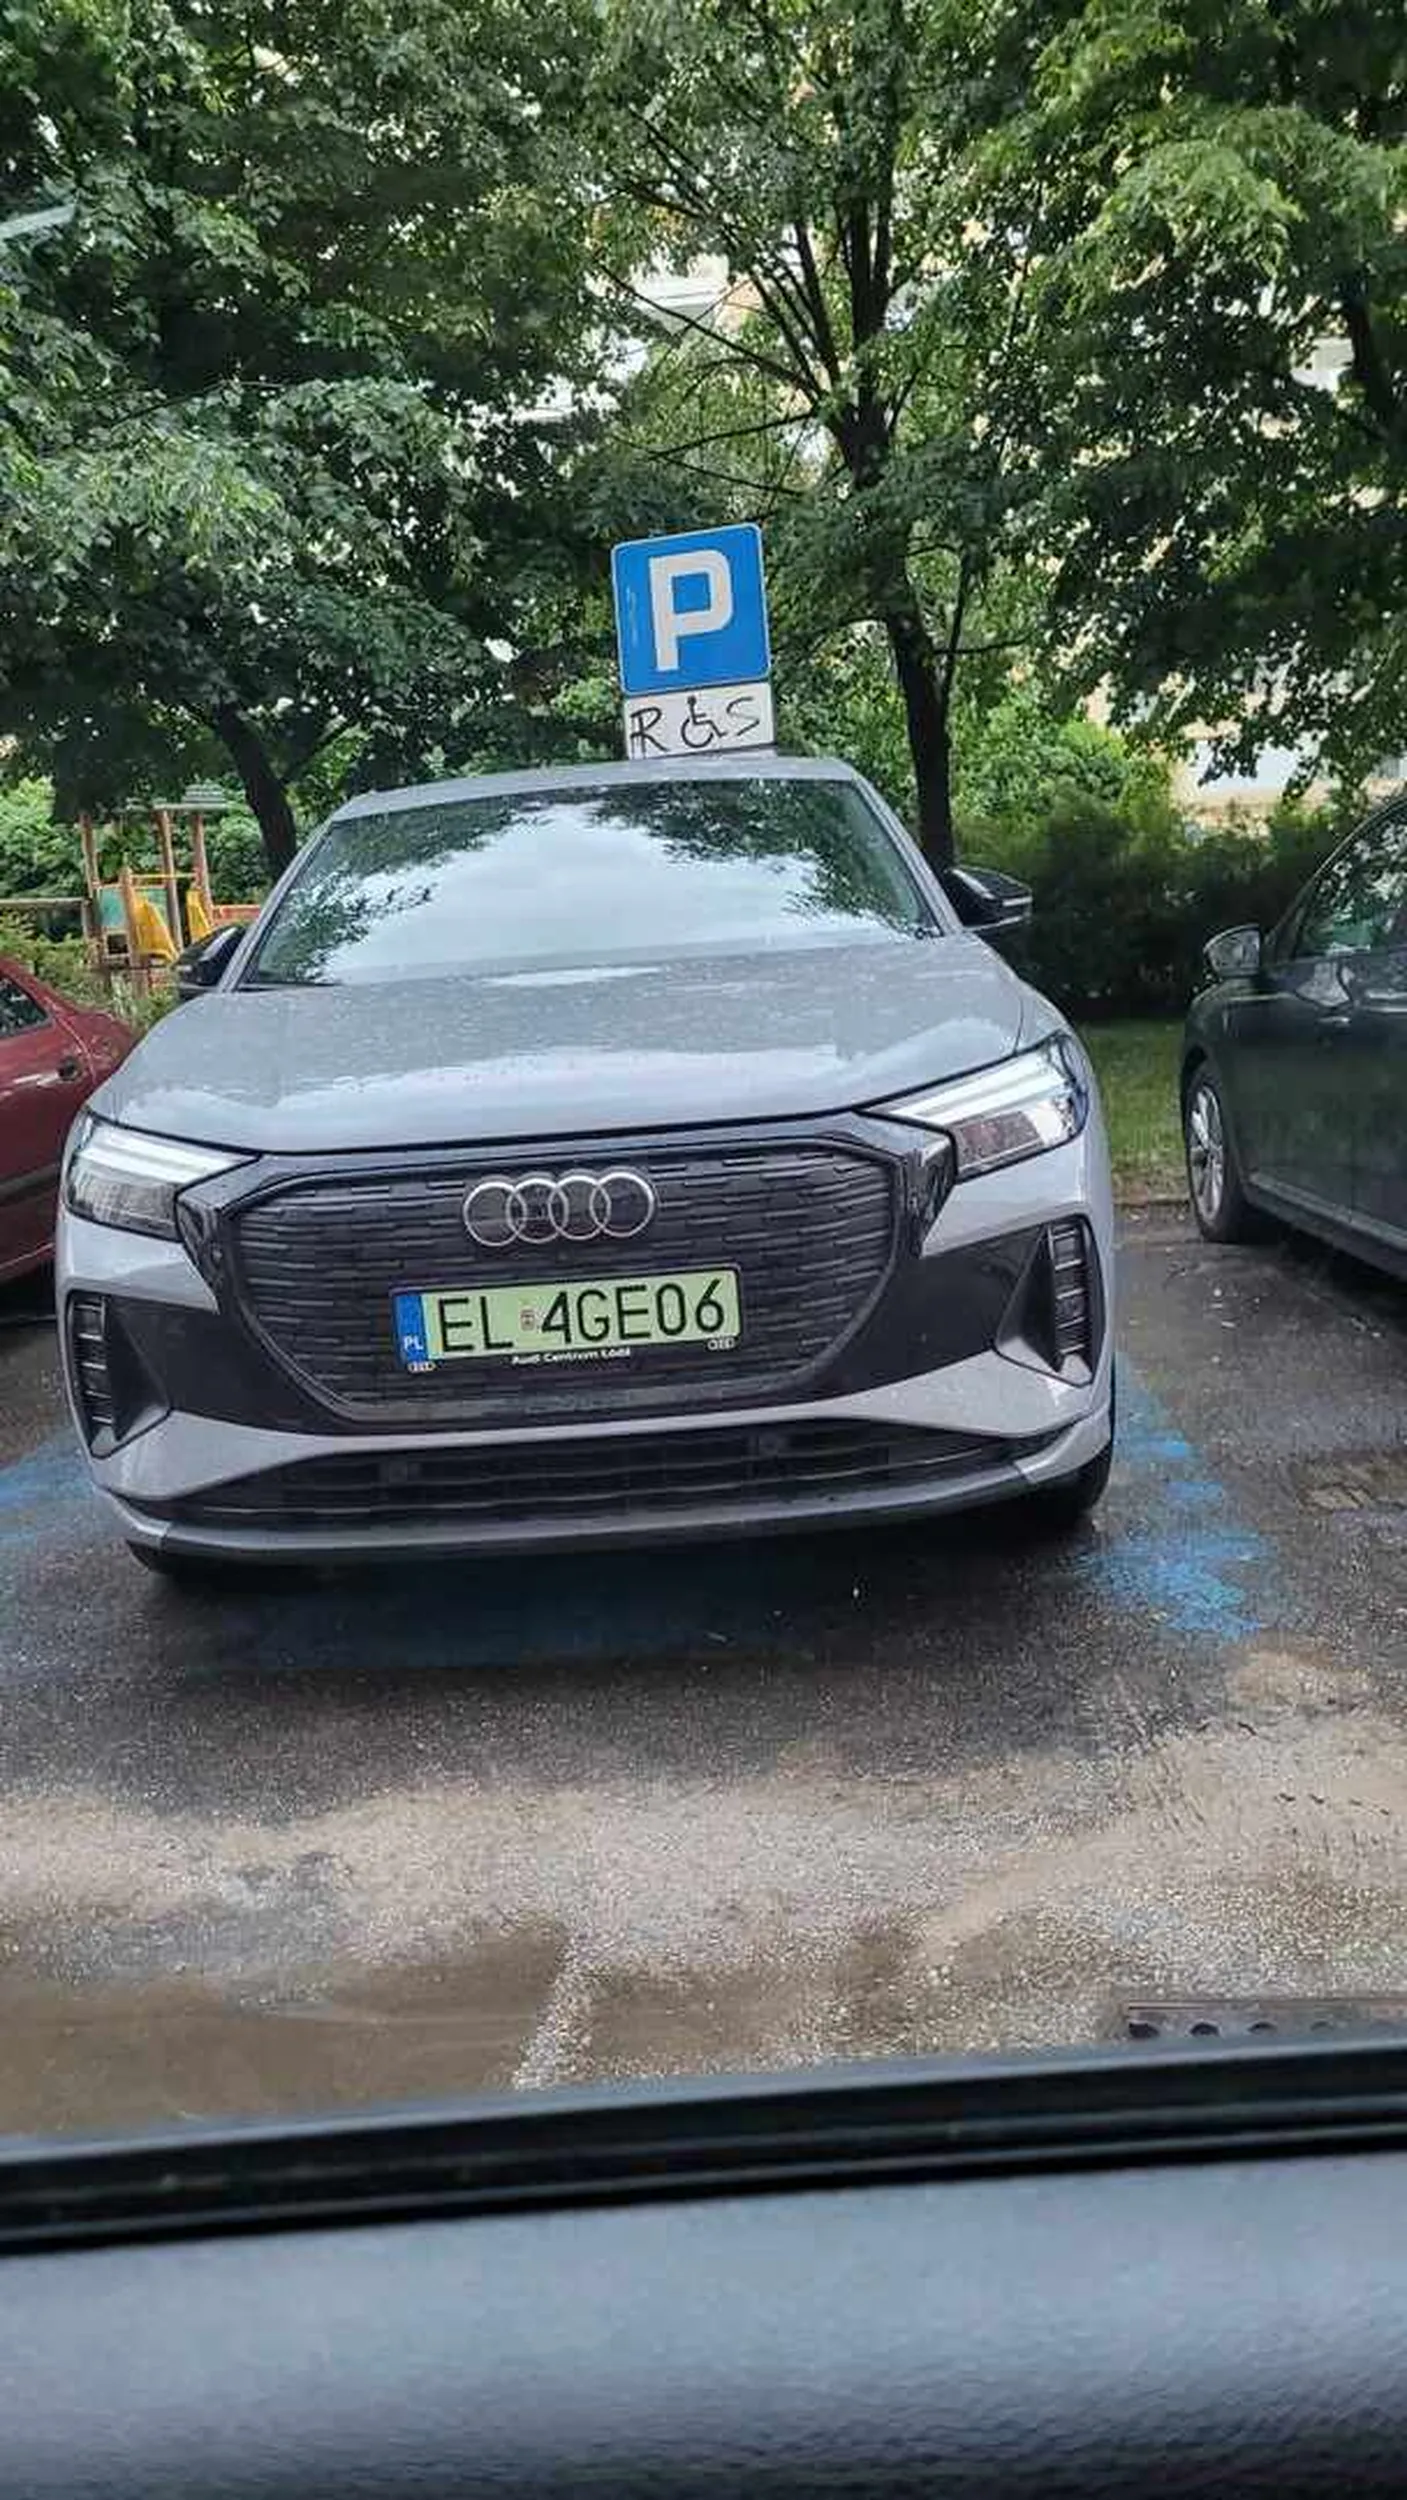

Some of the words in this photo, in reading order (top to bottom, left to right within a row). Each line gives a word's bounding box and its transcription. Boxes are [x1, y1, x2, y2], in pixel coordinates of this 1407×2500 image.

[650, 549, 733, 672] P
[403, 1335, 424, 1351] PL
[438, 1296, 514, 1352] EL
[541, 1278, 725, 1344] 4GE06
